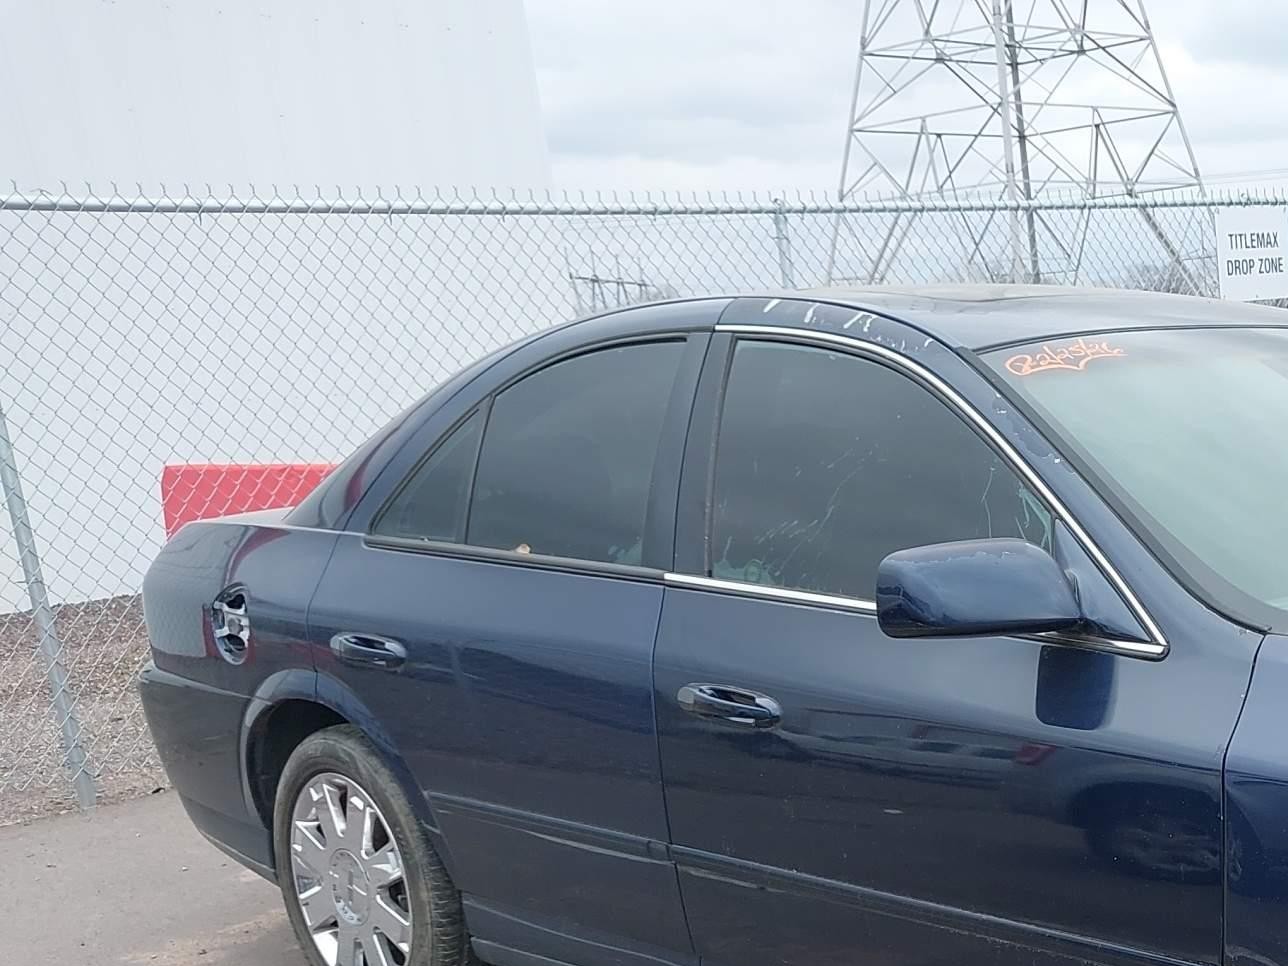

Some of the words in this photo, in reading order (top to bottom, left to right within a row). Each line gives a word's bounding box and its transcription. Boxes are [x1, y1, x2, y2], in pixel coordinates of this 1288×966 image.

[1227, 231, 1280, 250] TITLEMAX
[1226, 259, 1255, 276] DROP
[1258, 256, 1284, 274] ZONE
